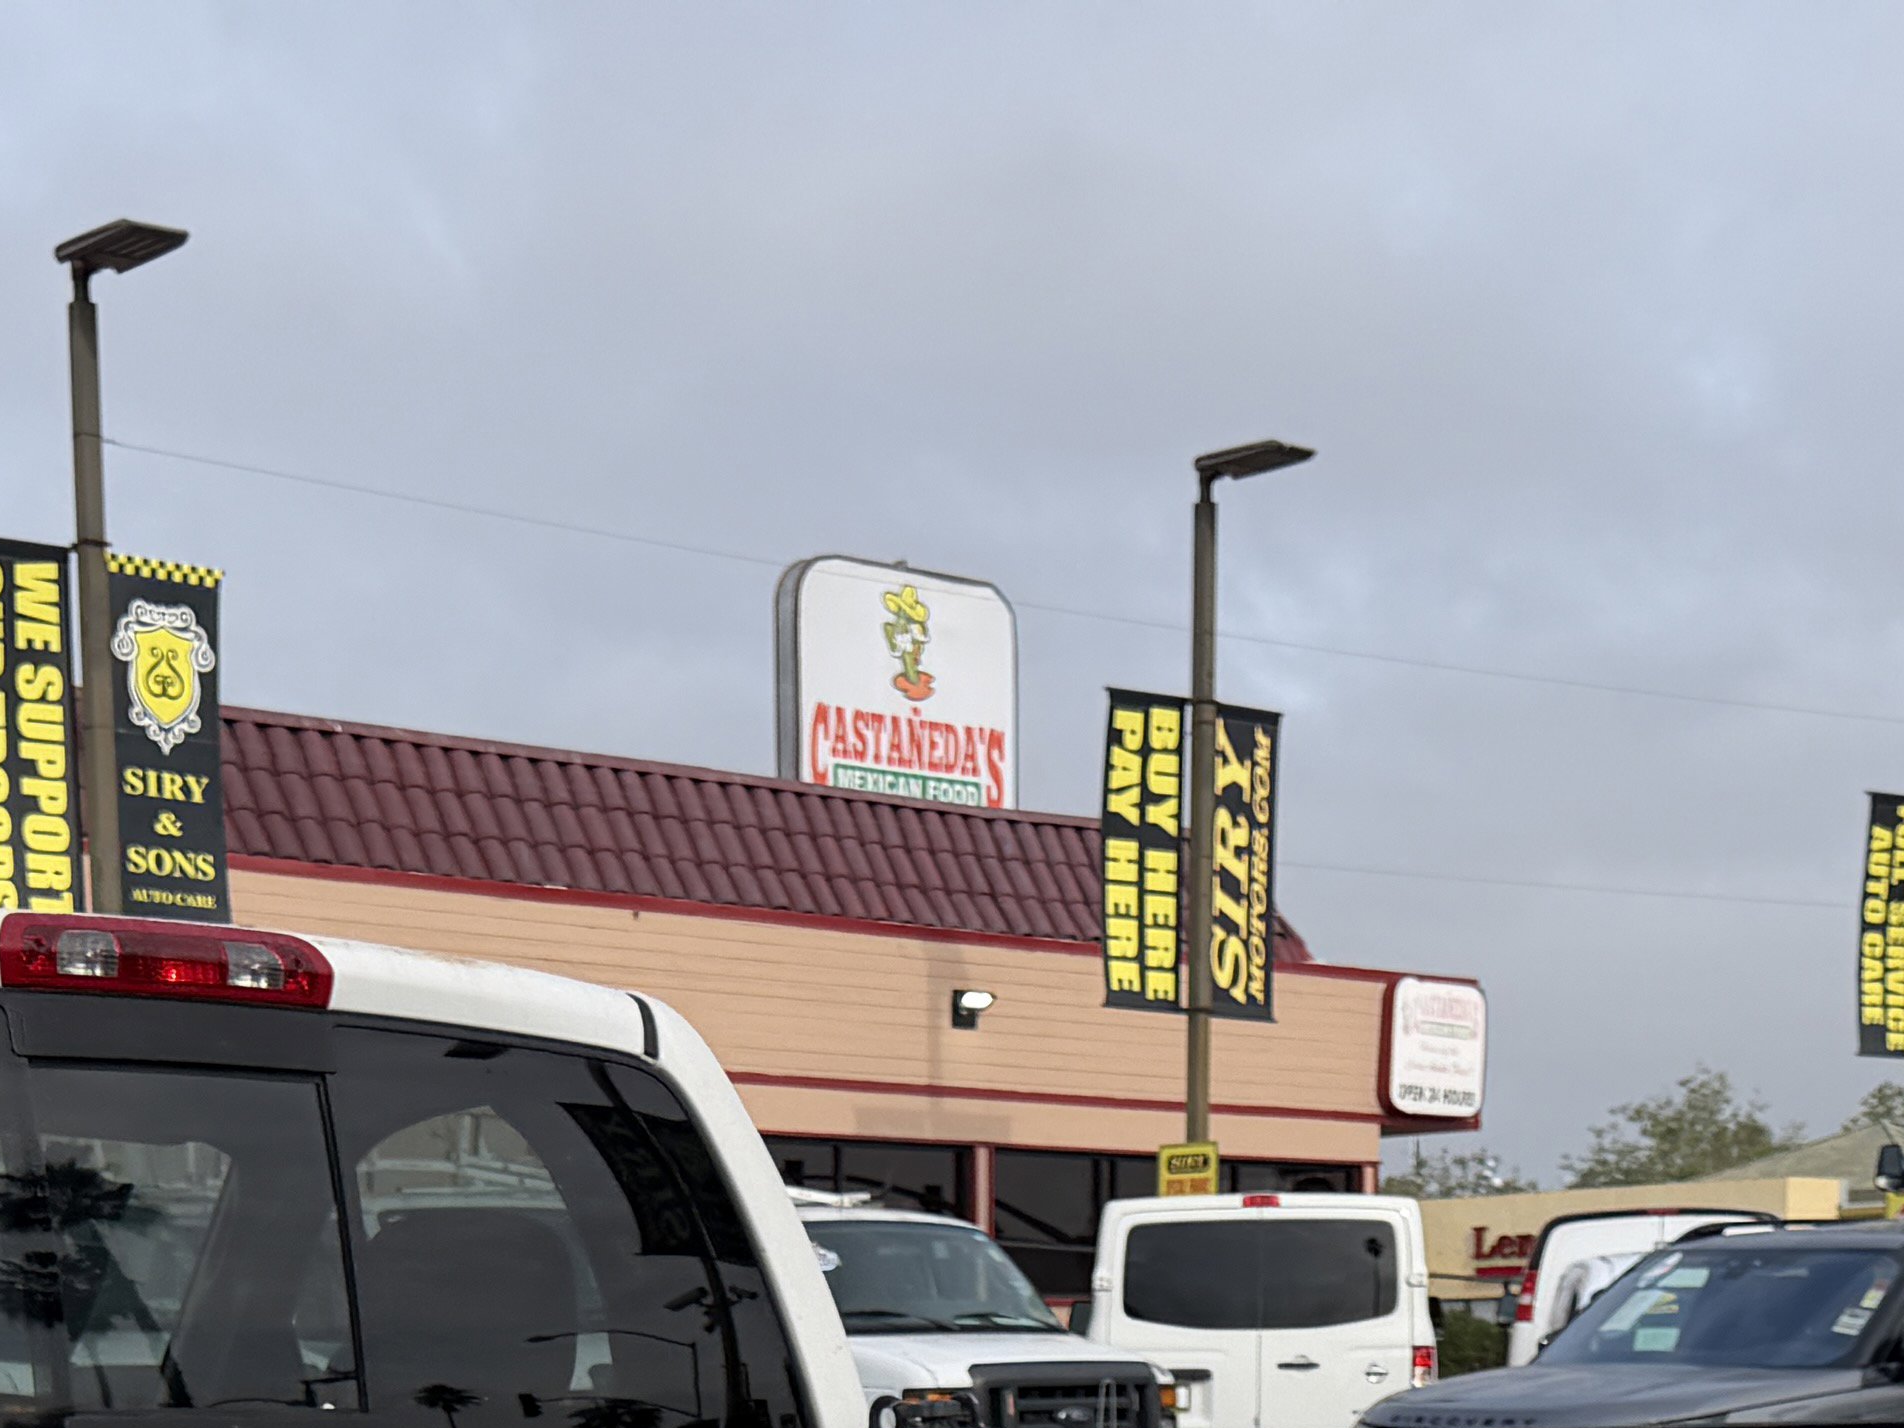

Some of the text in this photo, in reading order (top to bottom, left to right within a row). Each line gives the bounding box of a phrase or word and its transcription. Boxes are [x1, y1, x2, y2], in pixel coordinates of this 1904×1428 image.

[13, 562, 74, 914] WE SUPPORT
[122, 766, 210, 804] SIRY
[153, 811, 184, 837] &
[837, 768, 980, 807] MEXICAN FOOD
[126, 844, 216, 881] SONS
[132, 888, 173, 906] AUTO
[1104, 708, 1145, 993] PAY HERE
[1143, 707, 1181, 1002] BUY HERE
[1209, 717, 1252, 1005] SIRY
[1248, 723, 1272, 1006] MOTORS.COM
[1861, 824, 1894, 1025] AUTO CARE
